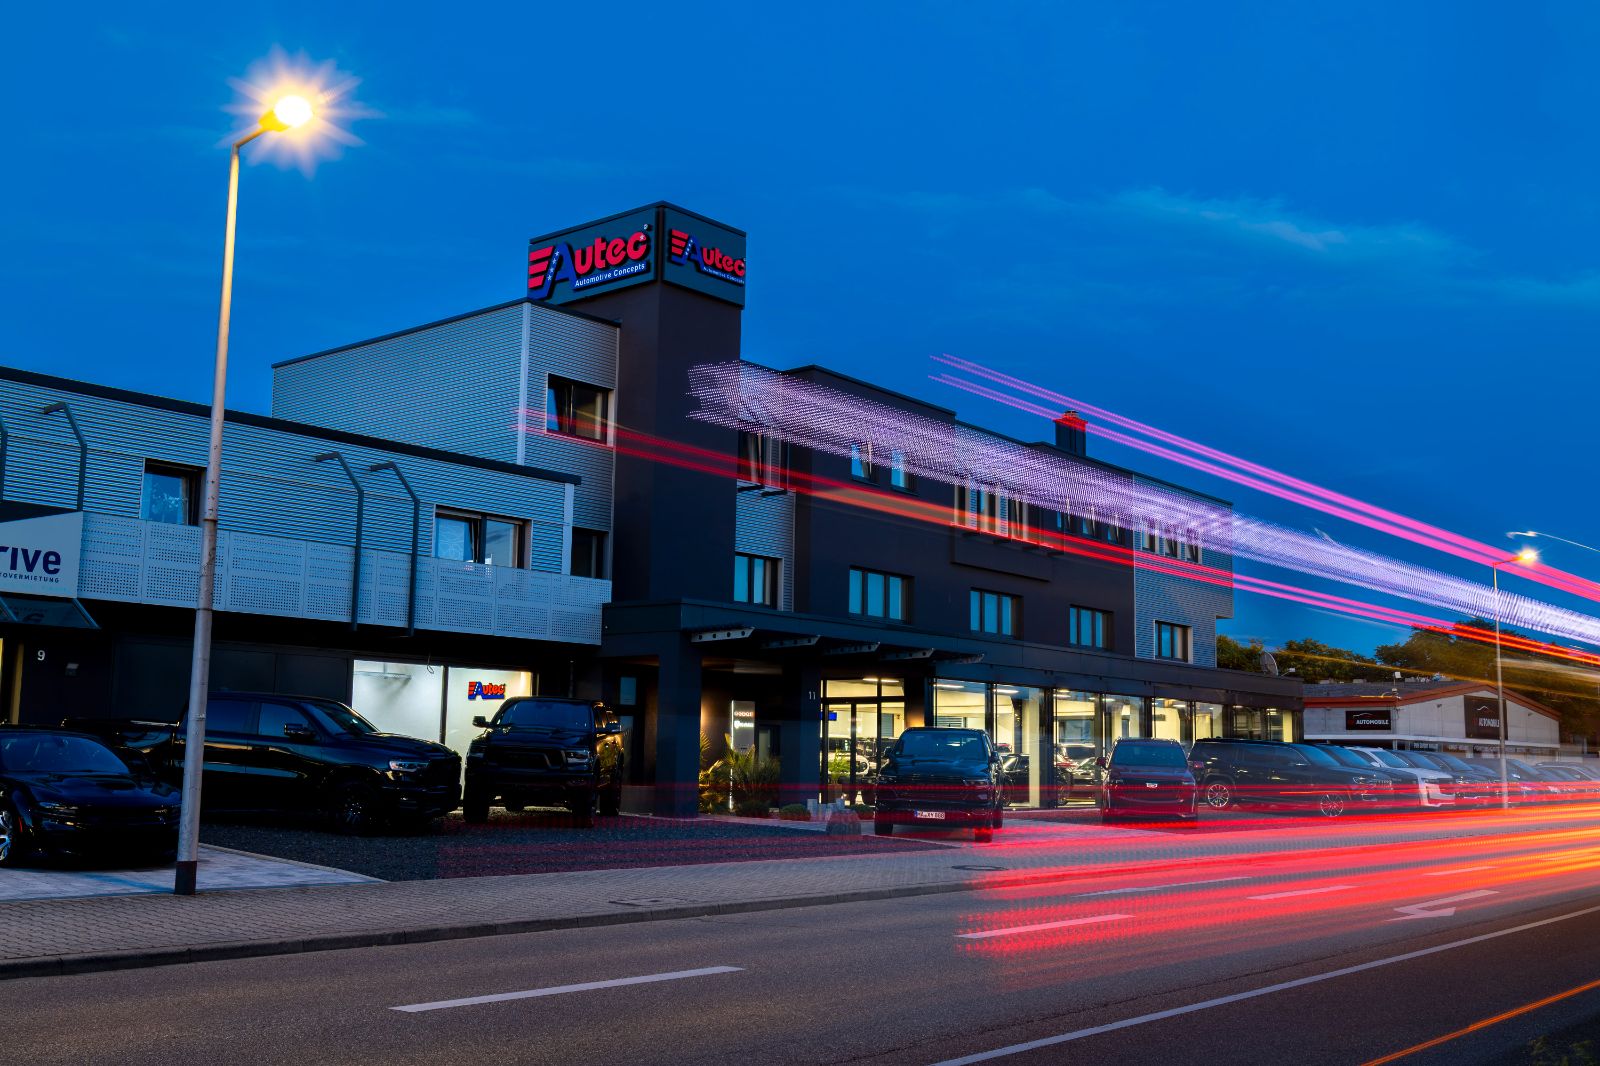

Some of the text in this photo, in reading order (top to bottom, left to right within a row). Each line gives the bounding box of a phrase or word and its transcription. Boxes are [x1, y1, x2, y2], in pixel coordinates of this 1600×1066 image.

[671, 229, 745, 277] Autec
[527, 231, 647, 300] Autec
[575, 263, 645, 287] Automotive Concepts
[37, 649, 46, 661] 9
[468, 681, 505, 700] Autec
[808, 691, 816, 700] 11
